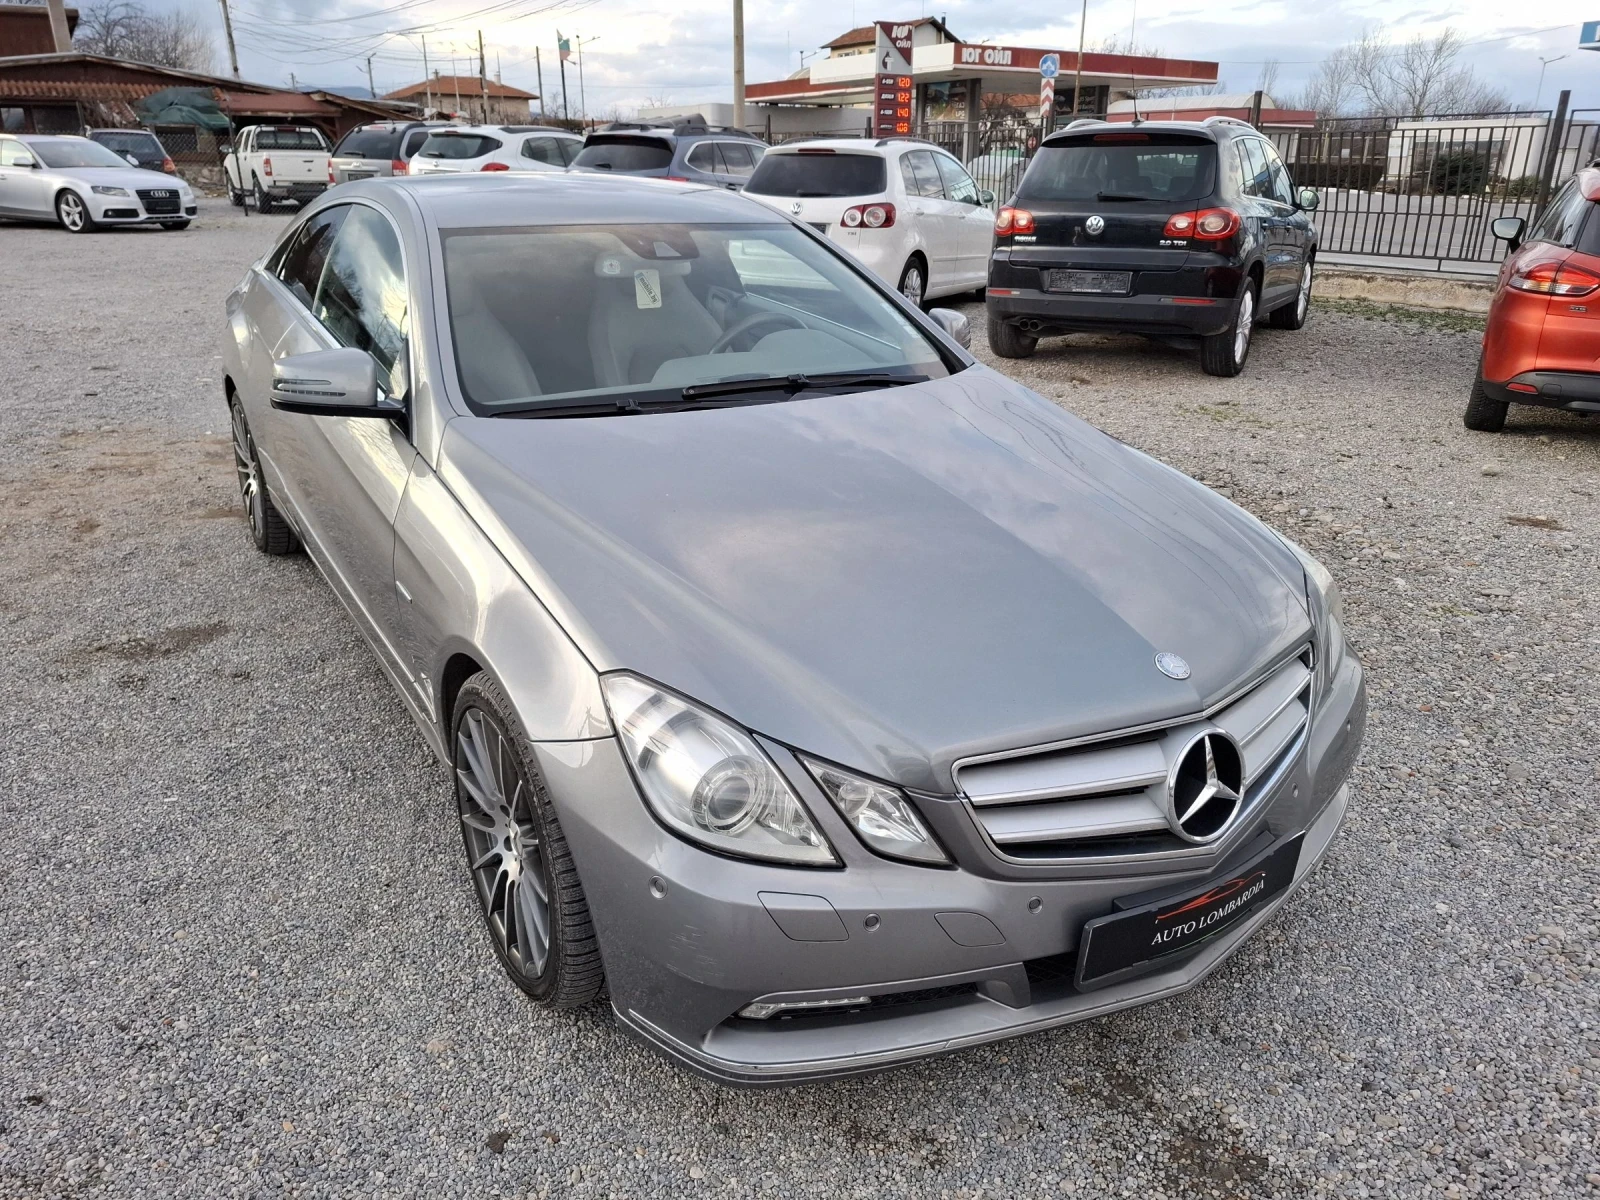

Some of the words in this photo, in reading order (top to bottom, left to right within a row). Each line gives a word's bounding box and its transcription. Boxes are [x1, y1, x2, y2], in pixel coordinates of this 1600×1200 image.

[962, 48, 982, 63] ЮГ
[984, 46, 1012, 65] ОЙЛ
[1151, 920, 1196, 945] AUTO
[1198, 879, 1265, 930] LOMBARDIA
